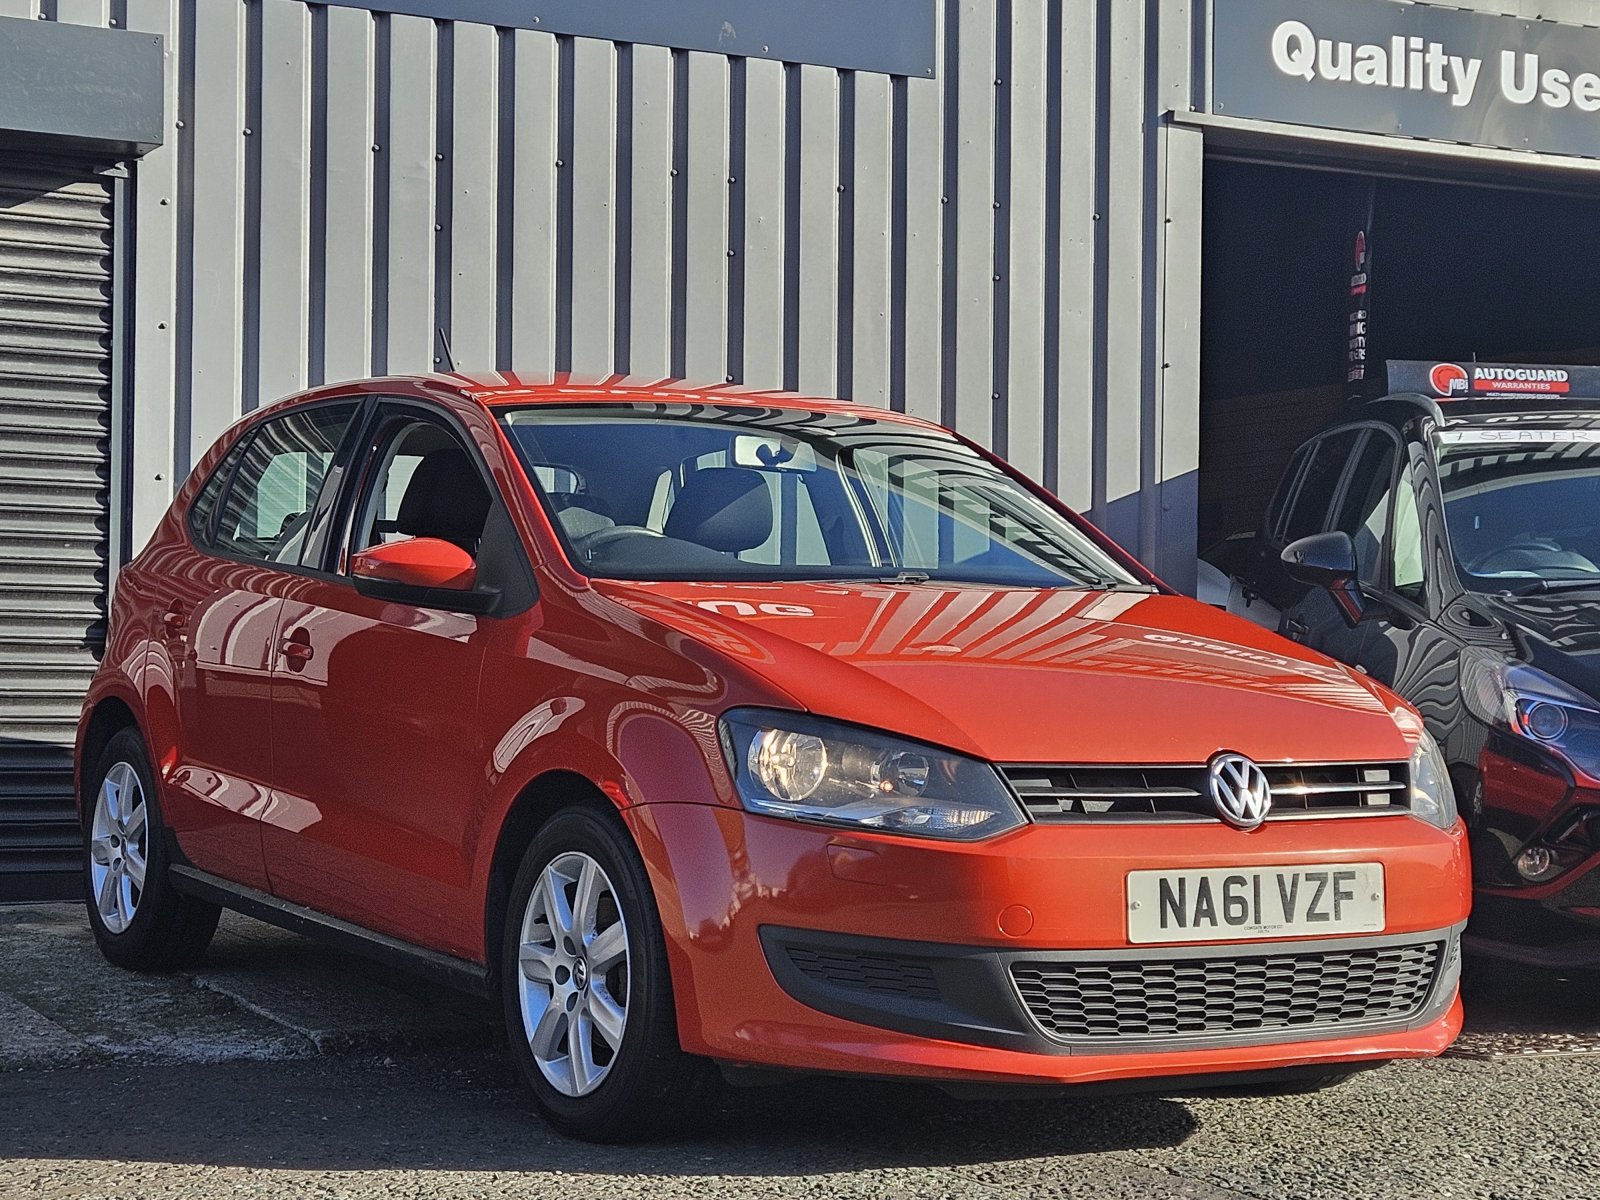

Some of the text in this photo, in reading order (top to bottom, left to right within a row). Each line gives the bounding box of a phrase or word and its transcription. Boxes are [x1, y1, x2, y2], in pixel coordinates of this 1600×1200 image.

[1271, 20, 1482, 107] Quality
[1474, 367, 1569, 382] AUTOGUARD
[1492, 382, 1551, 390] WARRANTIES
[1480, 431, 1591, 441] SEATER
[1158, 871, 1356, 929] NA61 VZF
